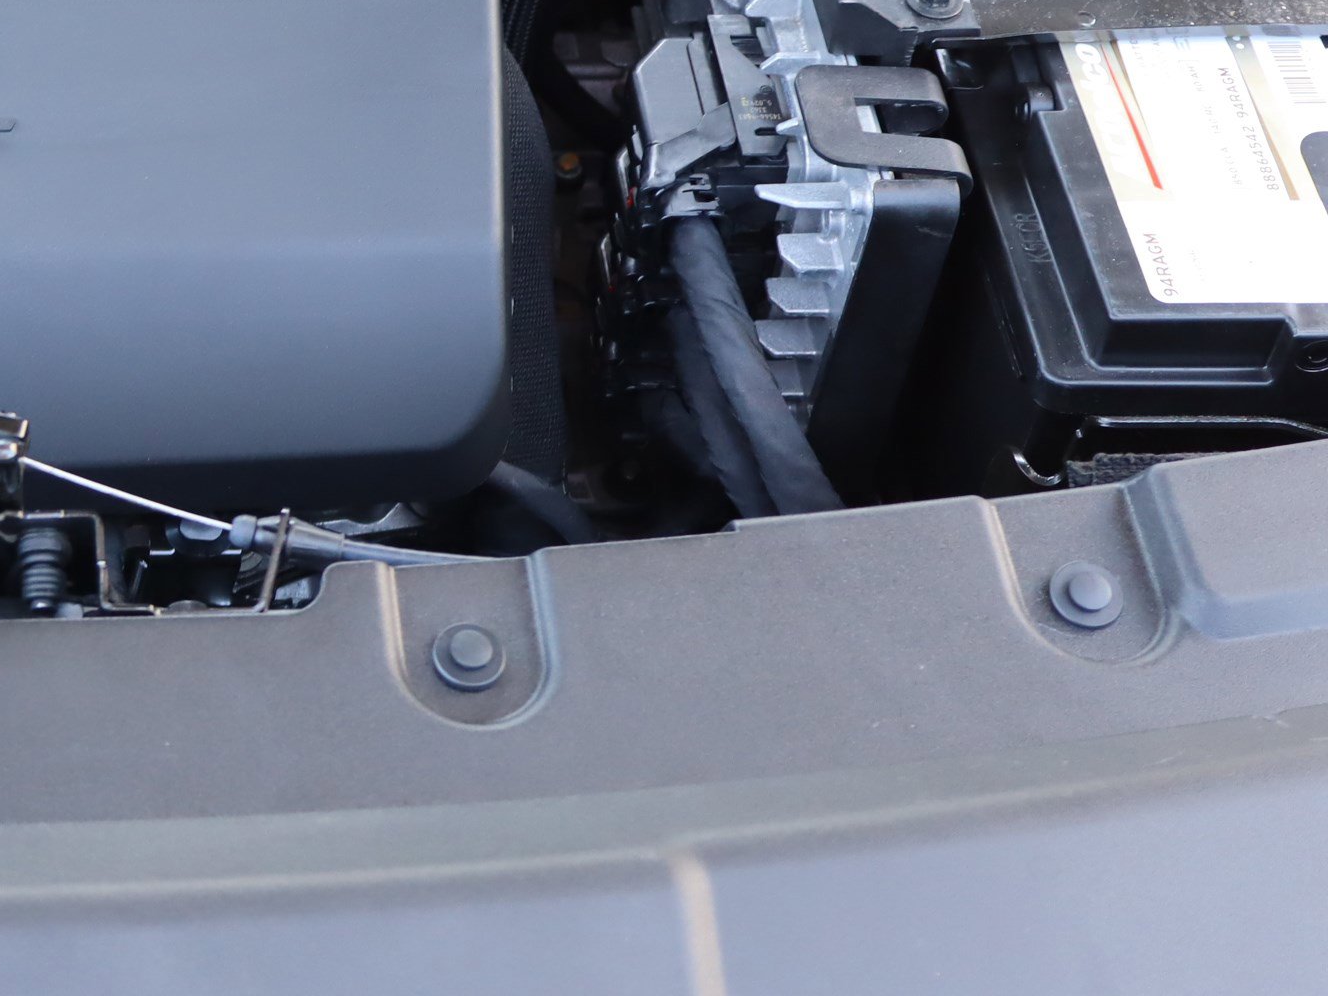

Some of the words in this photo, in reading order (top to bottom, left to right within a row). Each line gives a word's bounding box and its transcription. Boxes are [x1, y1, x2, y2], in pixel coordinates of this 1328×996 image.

[1218, 68, 1249, 118] 94RAGM
[1243, 126, 1279, 191] 88864542
[1143, 233, 1179, 297] 94RAGM
